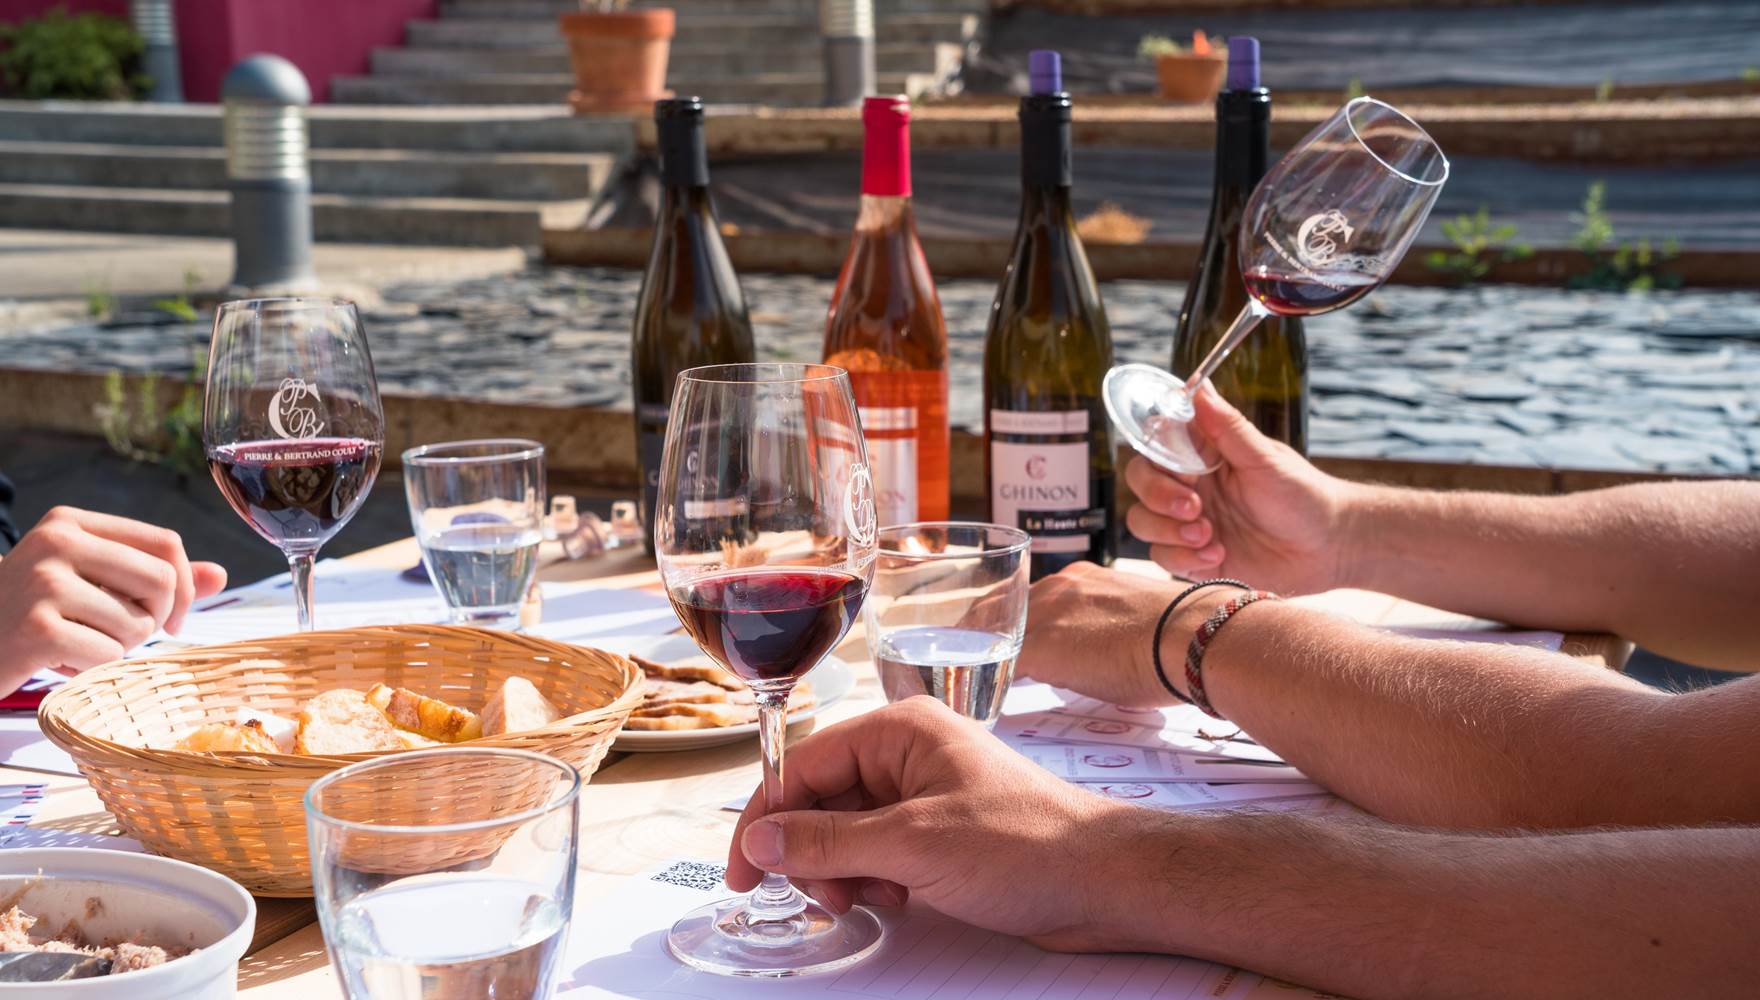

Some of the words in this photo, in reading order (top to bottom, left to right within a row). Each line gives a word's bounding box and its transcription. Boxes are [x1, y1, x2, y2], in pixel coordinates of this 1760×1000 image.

[244, 452, 273, 461] PIERRE
[274, 452, 282, 461] &
[284, 449, 331, 461] BERTRAND
[1000, 484, 1078, 501] CHINON
[1026, 518, 1042, 530] La
